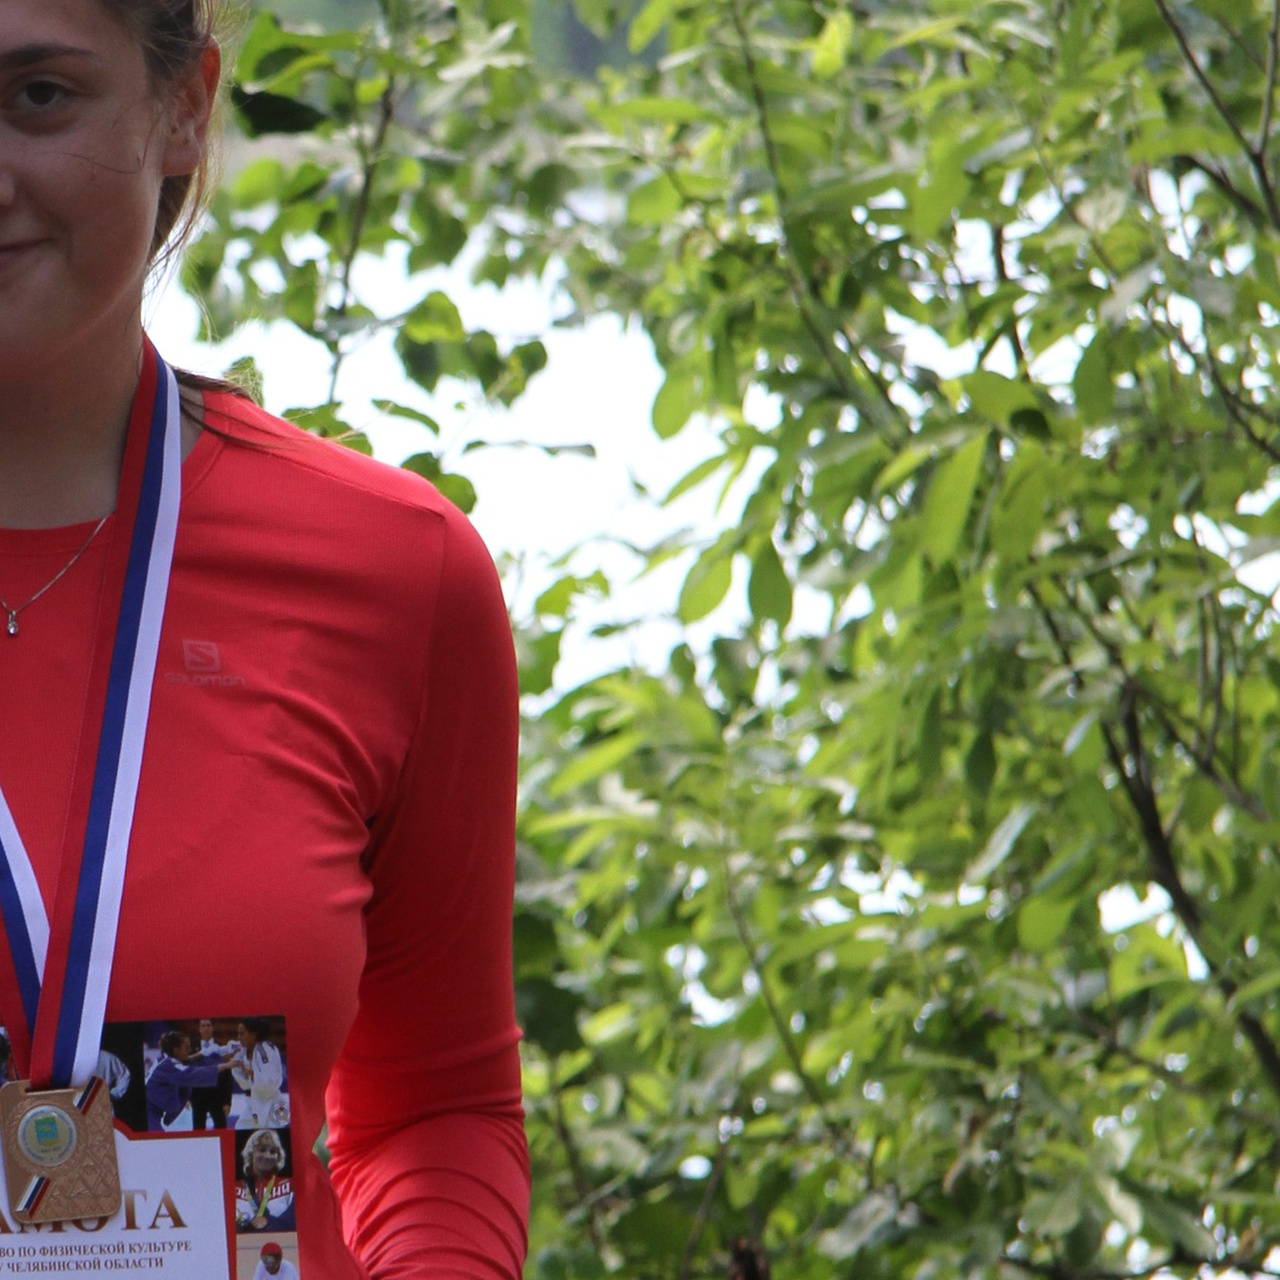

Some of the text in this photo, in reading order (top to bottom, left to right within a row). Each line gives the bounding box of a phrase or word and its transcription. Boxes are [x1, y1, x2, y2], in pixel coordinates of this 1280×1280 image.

[18, 1246, 36, 1258] ПО
[38, 1241, 126, 1257] ФИЗИЧЕСКОЙ
[128, 1240, 192, 1254] КУЛЬТУРЕ
[7, 1257, 101, 1273] ЧЕЛЯБИНСКОЙ
[104, 1256, 164, 1270] ОБЛАСТИ
